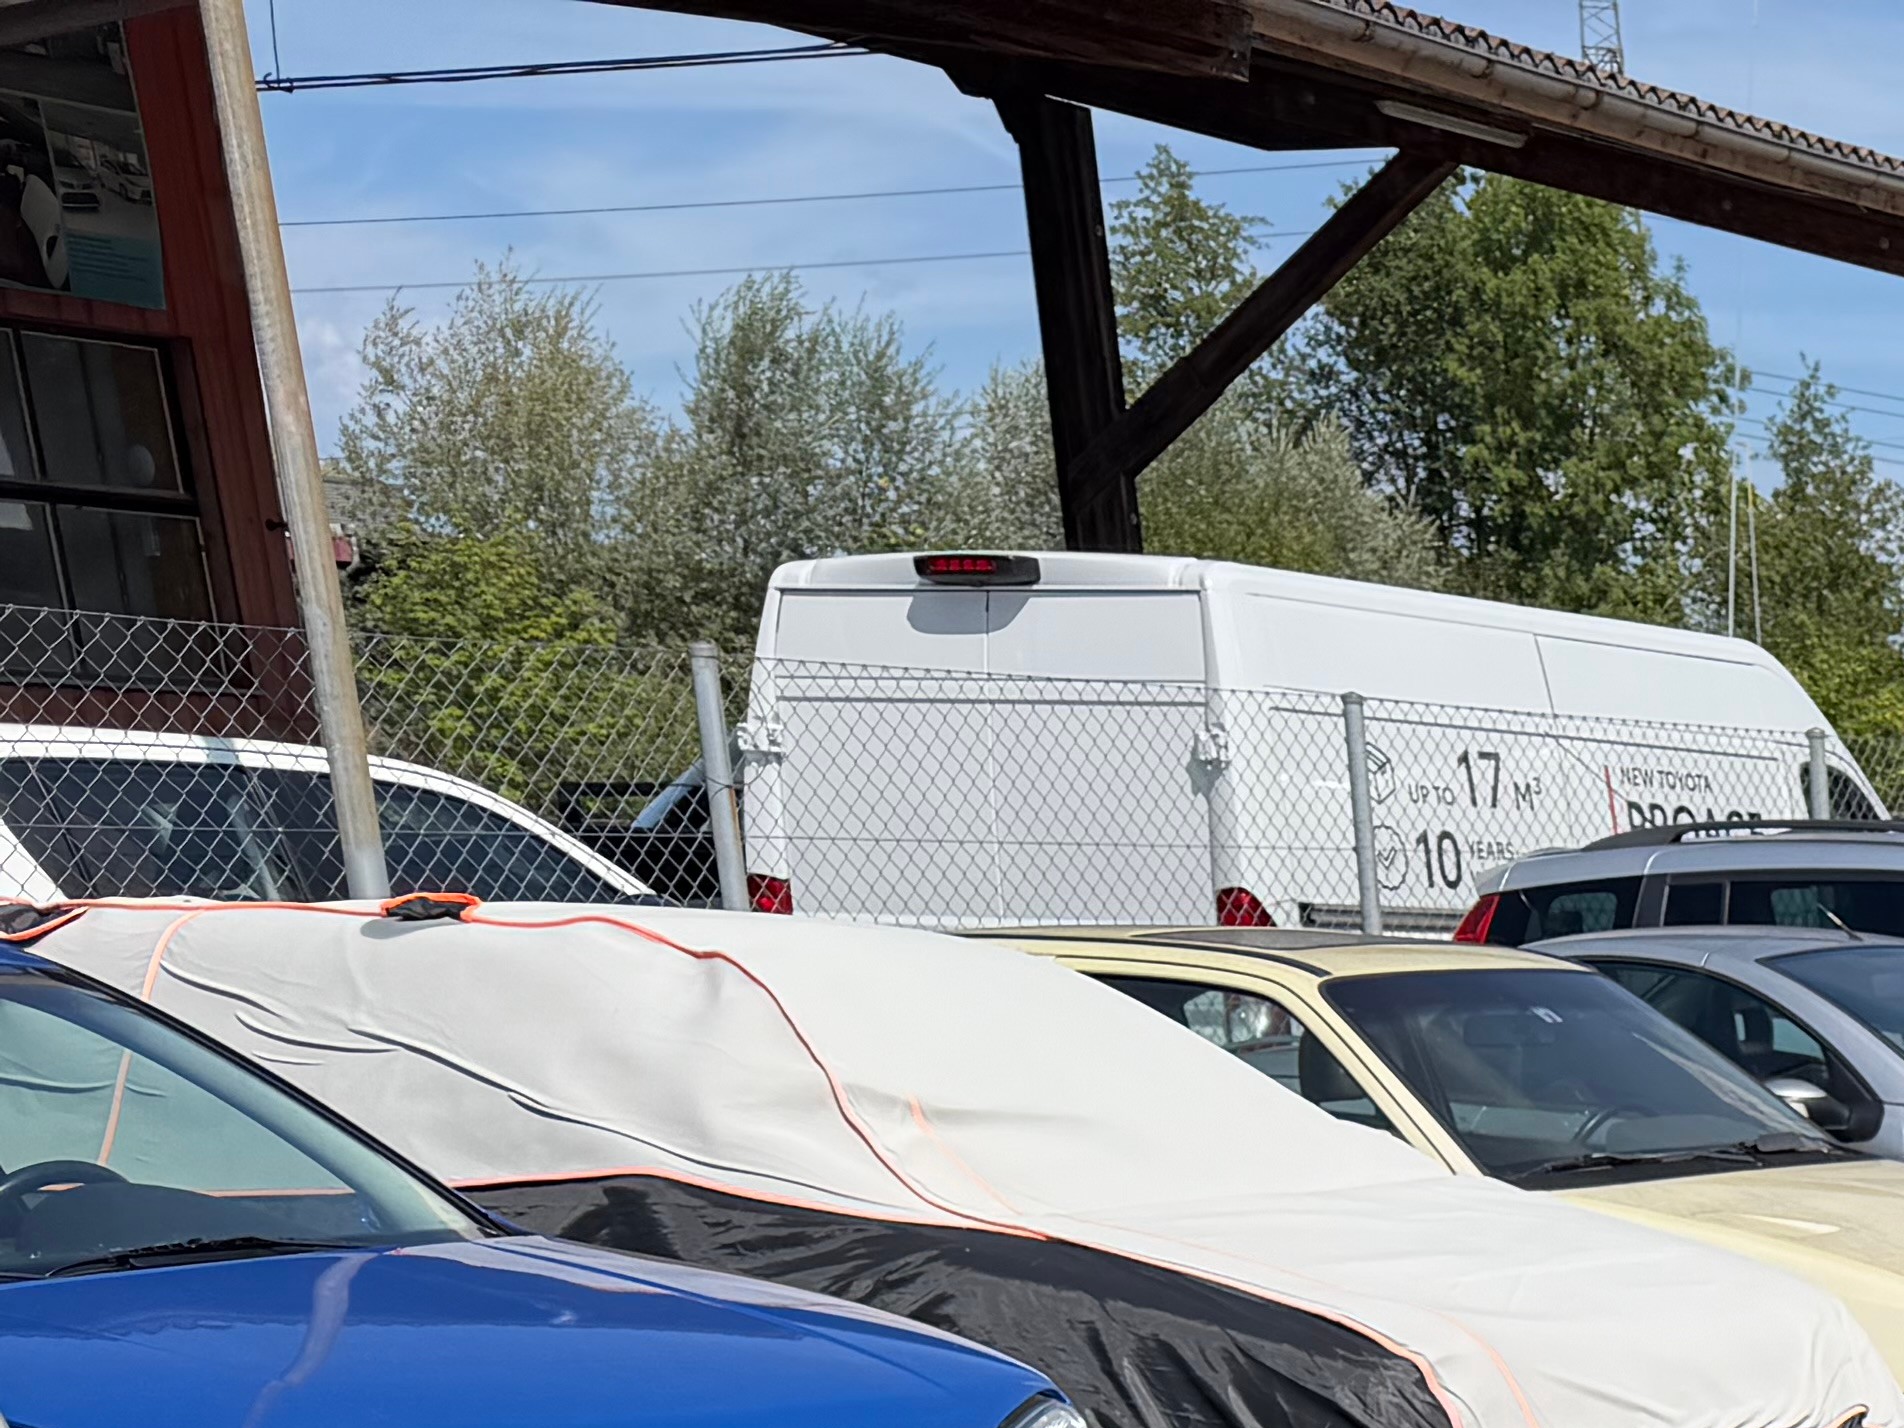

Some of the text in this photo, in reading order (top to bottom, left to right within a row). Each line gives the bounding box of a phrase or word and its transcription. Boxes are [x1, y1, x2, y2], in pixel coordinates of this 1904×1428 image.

[1408, 783, 1429, 804] UP
[1432, 785, 1456, 806] TO
[1457, 749, 1500, 808] 17
[1621, 767, 1713, 794] NEW TOYOTA
[1416, 829, 1514, 890] 10 YEARS
